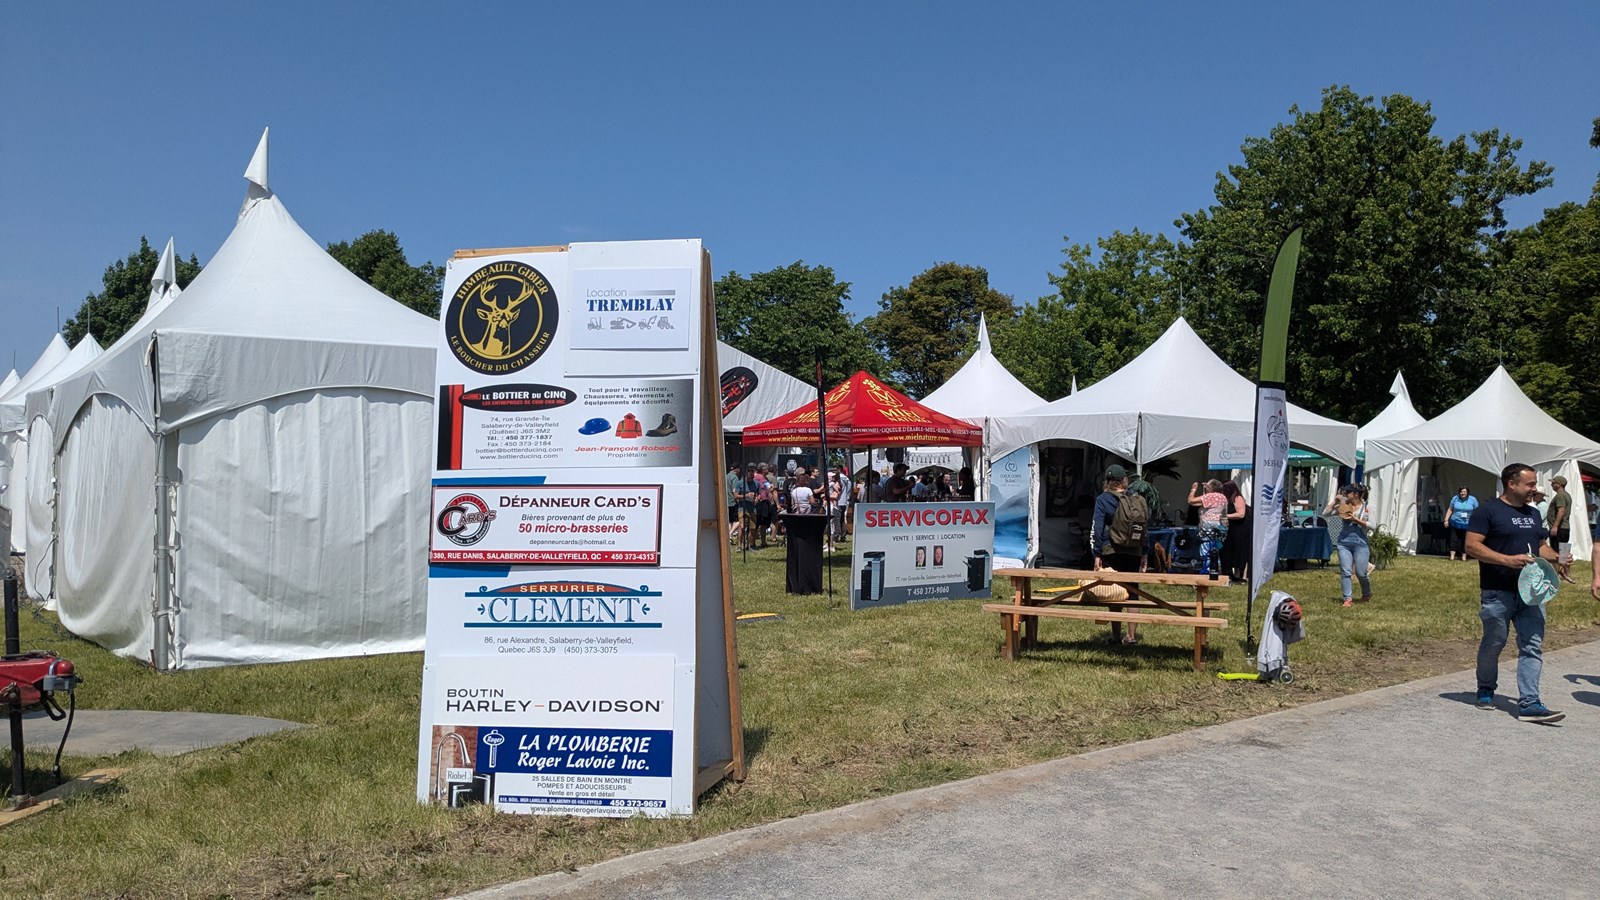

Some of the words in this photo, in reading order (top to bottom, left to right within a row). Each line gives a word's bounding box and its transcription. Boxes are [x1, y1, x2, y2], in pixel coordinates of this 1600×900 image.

[456, 263, 517, 300] HIMBEAULT
[517, 266, 549, 295] GIBIER
[586, 288, 627, 297] Location
[586, 298, 675, 312] TREMBLAY
[450, 335, 459, 347] LE
[456, 346, 493, 371] BOUCHER
[495, 364, 509, 372] DU
[510, 331, 551, 368] CHASSEUR
[492, 391, 530, 400] BOTTIER
[543, 390, 566, 400] CINQ
[888, 433, 950, 441] www.mielnature.com
[499, 495, 590, 507] DÉPANNEUR
[594, 496, 651, 507] CARD'S
[546, 514, 584, 522] provenant
[597, 514, 614, 522] plus
[865, 507, 989, 528] SERVICOFAX
[518, 523, 532, 533] 50
[535, 523, 628, 533] micro-brasseries
[433, 552, 446, 560] 380,
[913, 588, 923, 596] 450
[924, 586, 949, 595] 373-9060
[488, 597, 641, 623] CLEMENT
[510, 636, 547, 645] Alexandre,
[549, 637, 634, 645] Salaberry-de-Valleyfield,
[498, 646, 525, 654] Quebec
[527, 646, 541, 654] J6S
[543, 646, 556, 654] 3J9
[564, 646, 583, 655] (450)
[584, 646, 618, 654] 373-3075
[447, 689, 504, 698] BOUTIN
[486, 736, 503, 744] Roger
[518, 734, 540, 751] LA
[546, 734, 652, 753] PLOMBERIE
[517, 751, 562, 771] Roger
[566, 753, 615, 769] Lavoie
[621, 754, 650, 771] Inc.
[447, 771, 467, 780] Riobel
[575, 783, 627, 791] ADOUCISSEURS
[626, 800, 664, 808] 373-9657
[530, 806, 633, 815] www.plomberierogerlavoie.com
